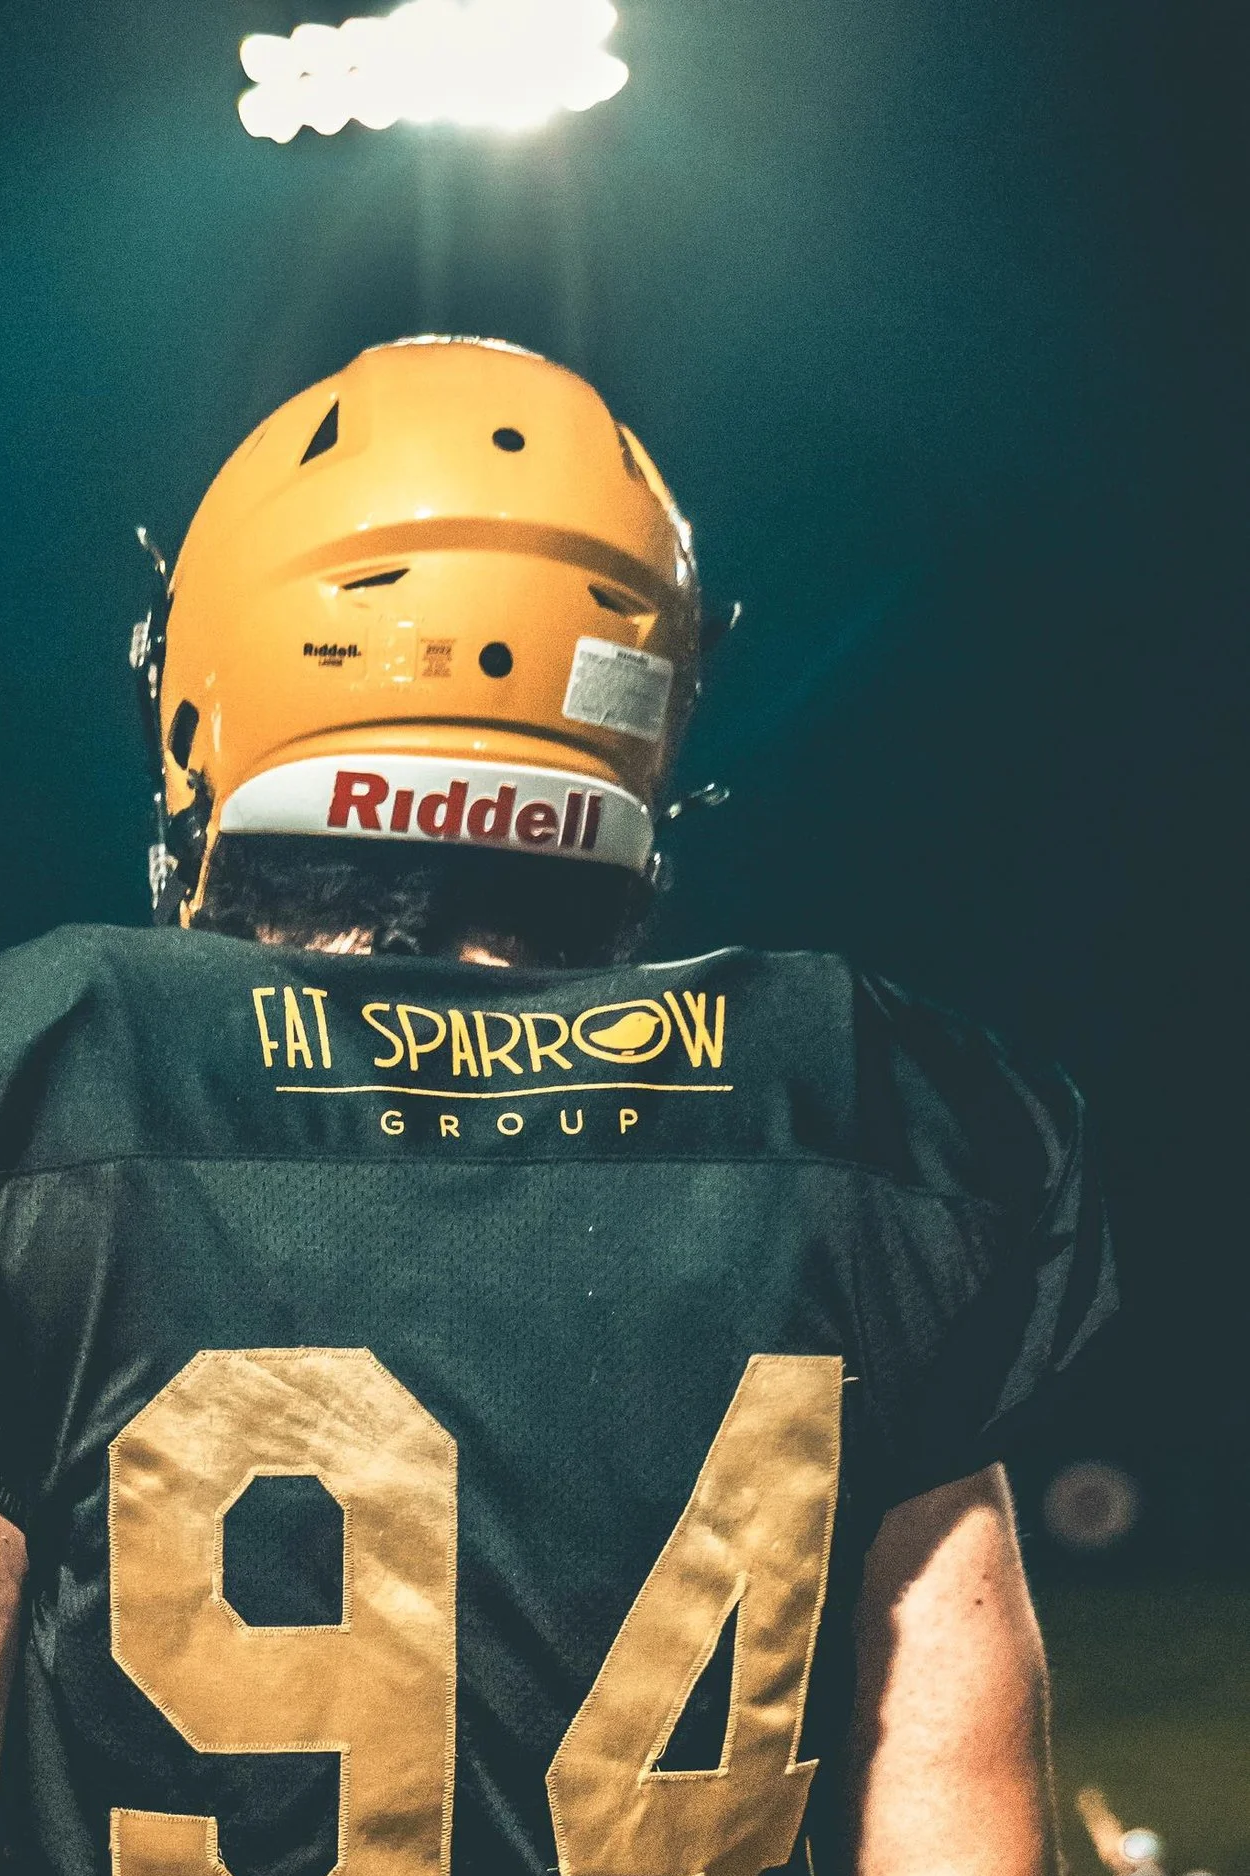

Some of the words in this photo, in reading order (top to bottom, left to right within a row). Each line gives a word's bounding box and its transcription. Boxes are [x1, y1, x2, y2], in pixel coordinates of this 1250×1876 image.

[327, 770, 601, 850] Riddell
[252, 985, 332, 1069] FAT
[361, 990, 726, 1078] SPARROW
[380, 1108, 639, 1138] GROUP
